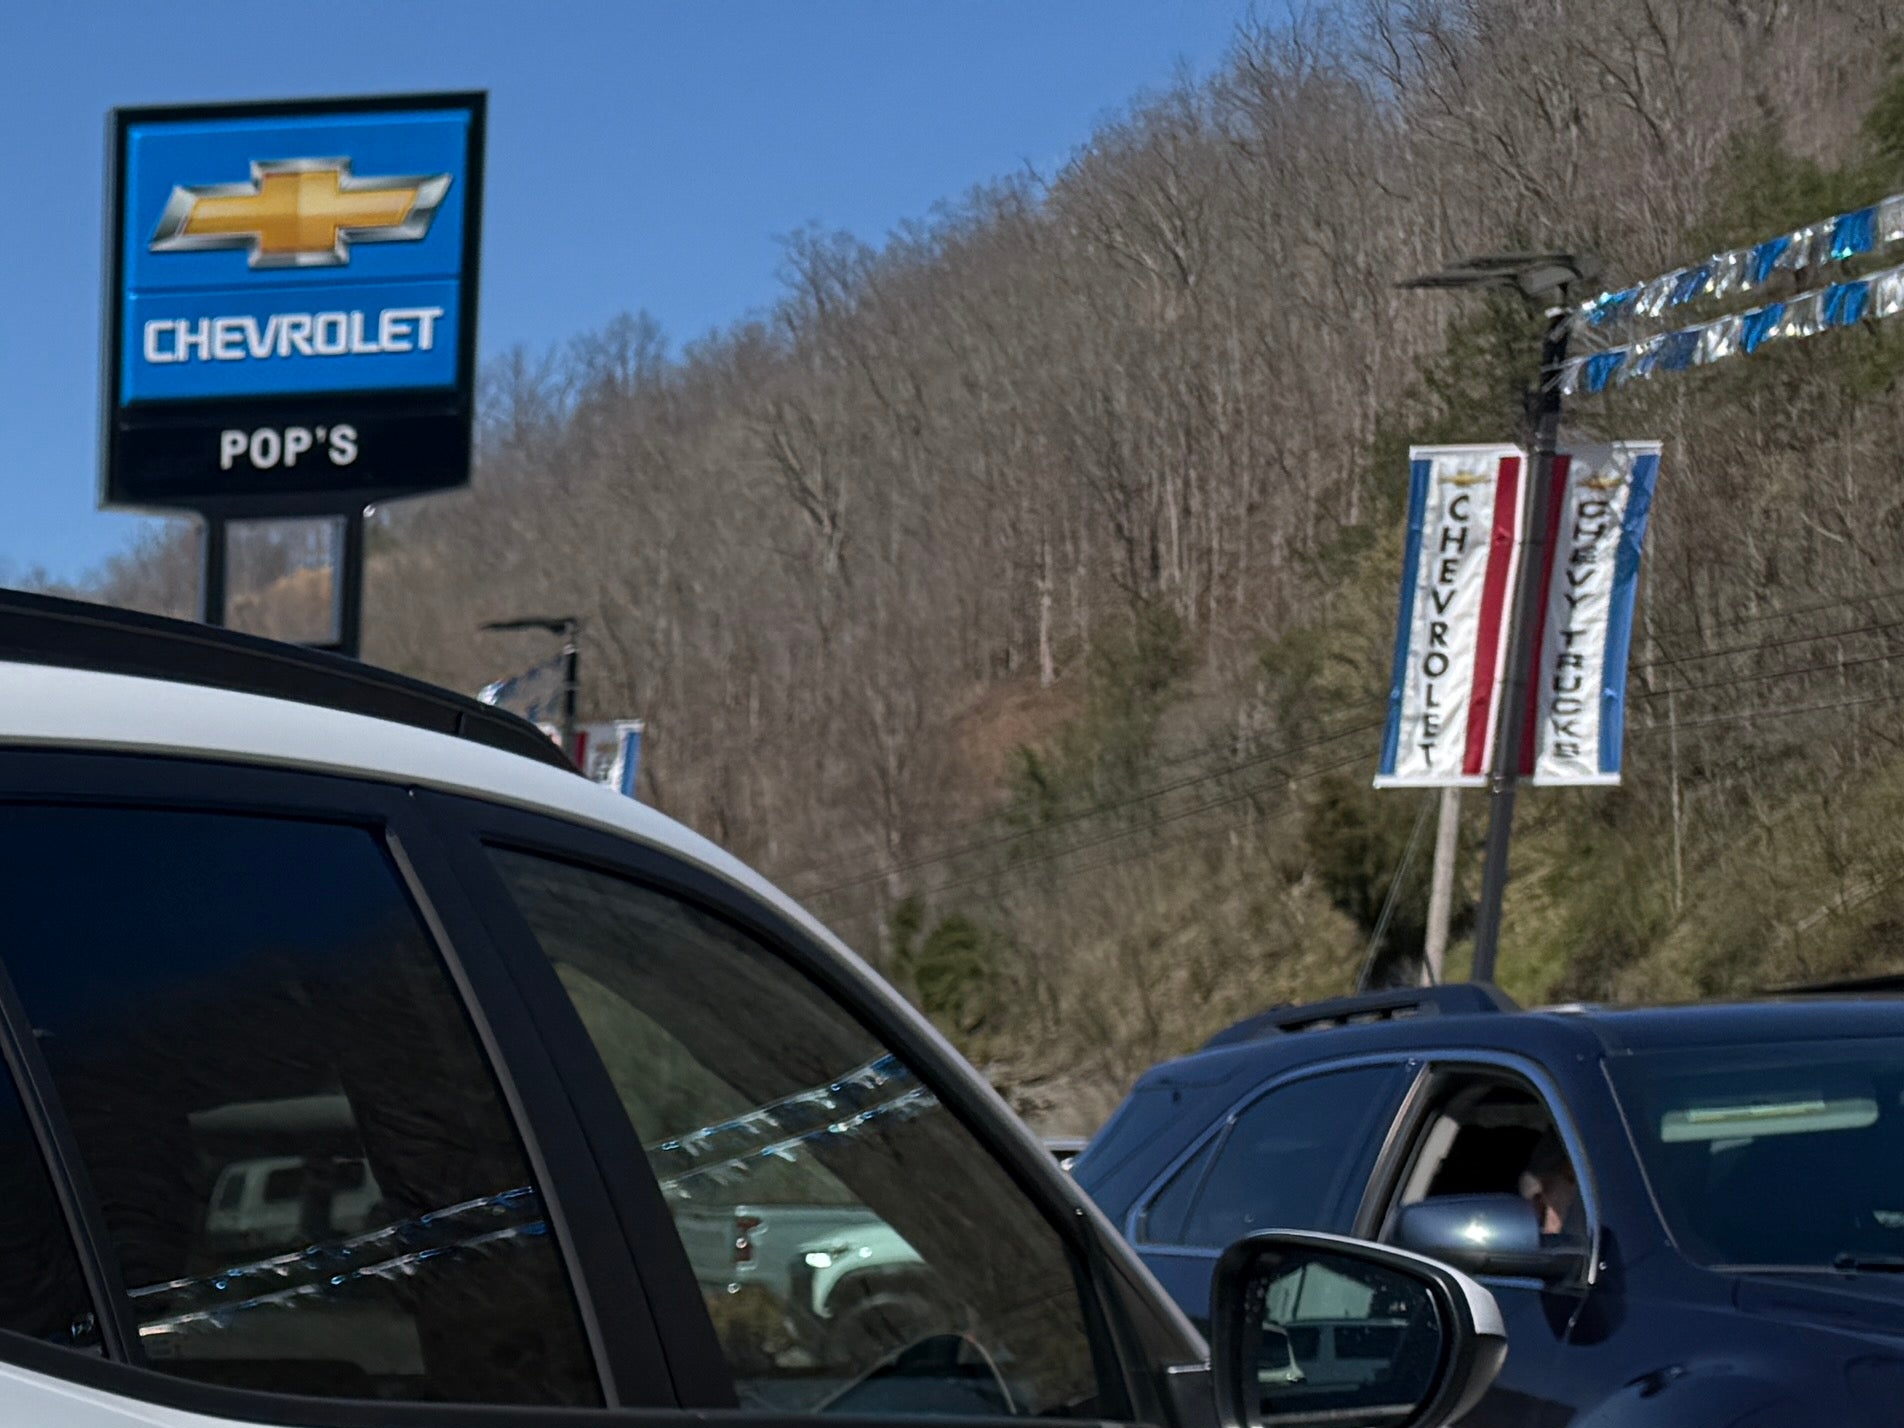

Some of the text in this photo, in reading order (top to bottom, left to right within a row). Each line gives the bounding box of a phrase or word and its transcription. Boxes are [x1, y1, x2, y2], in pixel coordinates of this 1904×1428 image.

[144, 307, 443, 363] CHEVROLET
[220, 424, 358, 470] POP'S
[1564, 500, 1610, 610] CHEVY
[1418, 495, 1470, 767] CHEVROLET
